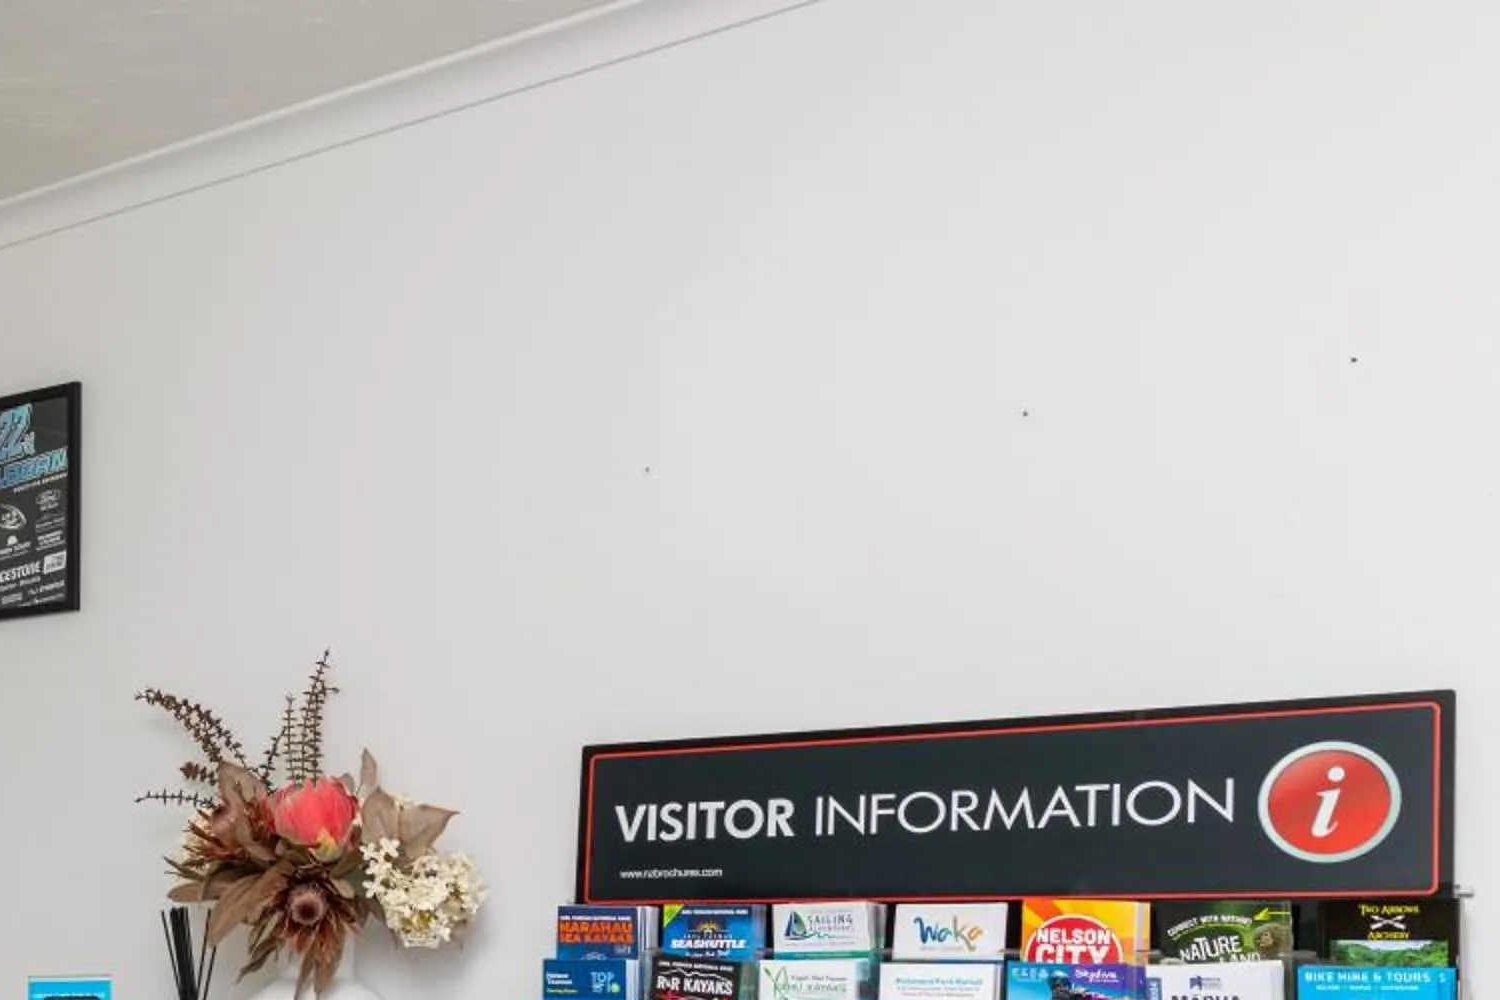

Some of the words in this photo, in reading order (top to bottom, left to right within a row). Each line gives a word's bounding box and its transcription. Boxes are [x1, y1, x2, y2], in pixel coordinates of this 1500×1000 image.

[615, 799, 794, 842] VISITOR
[815, 777, 1234, 836] INFORMATION
[1358, 905, 1379, 916] TWO
[807, 914, 853, 924] SAILING
[560, 921, 633, 933] MARAHAU
[913, 916, 984, 951] Waka
[1035, 928, 1111, 944] NELSON
[1367, 931, 1410, 941] ARCHERY
[671, 939, 746, 949] SEASHUTTLE
[1180, 935, 1242, 960] NATURE
[1035, 947, 1110, 964] CITY
[591, 971, 615, 983] TOP
[1305, 972, 1334, 982] BIKE
[1338, 972, 1368, 982] HIRE
[1387, 972, 1431, 983] TOURS
[683, 978, 733, 995] KAYAKS
